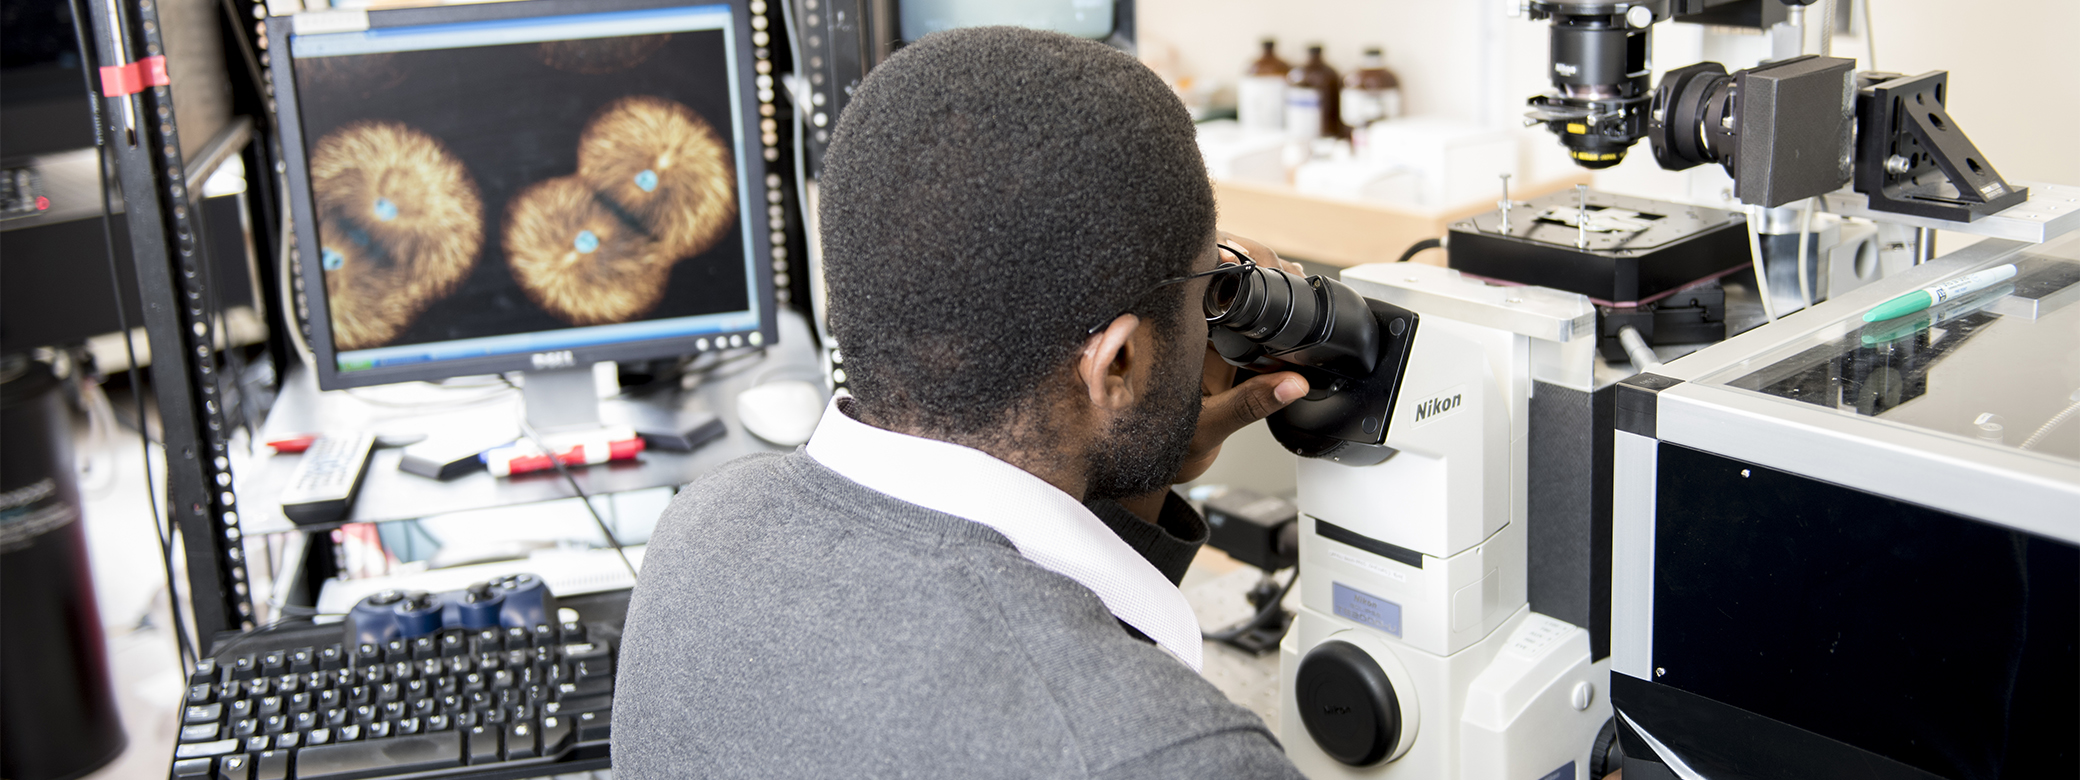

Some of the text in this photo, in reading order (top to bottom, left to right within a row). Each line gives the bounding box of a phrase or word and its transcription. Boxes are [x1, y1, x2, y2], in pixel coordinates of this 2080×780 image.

[1415, 393, 1462, 422] Nikon
[1354, 594, 1377, 609] Nikon
[1323, 704, 1351, 715] Nikon
